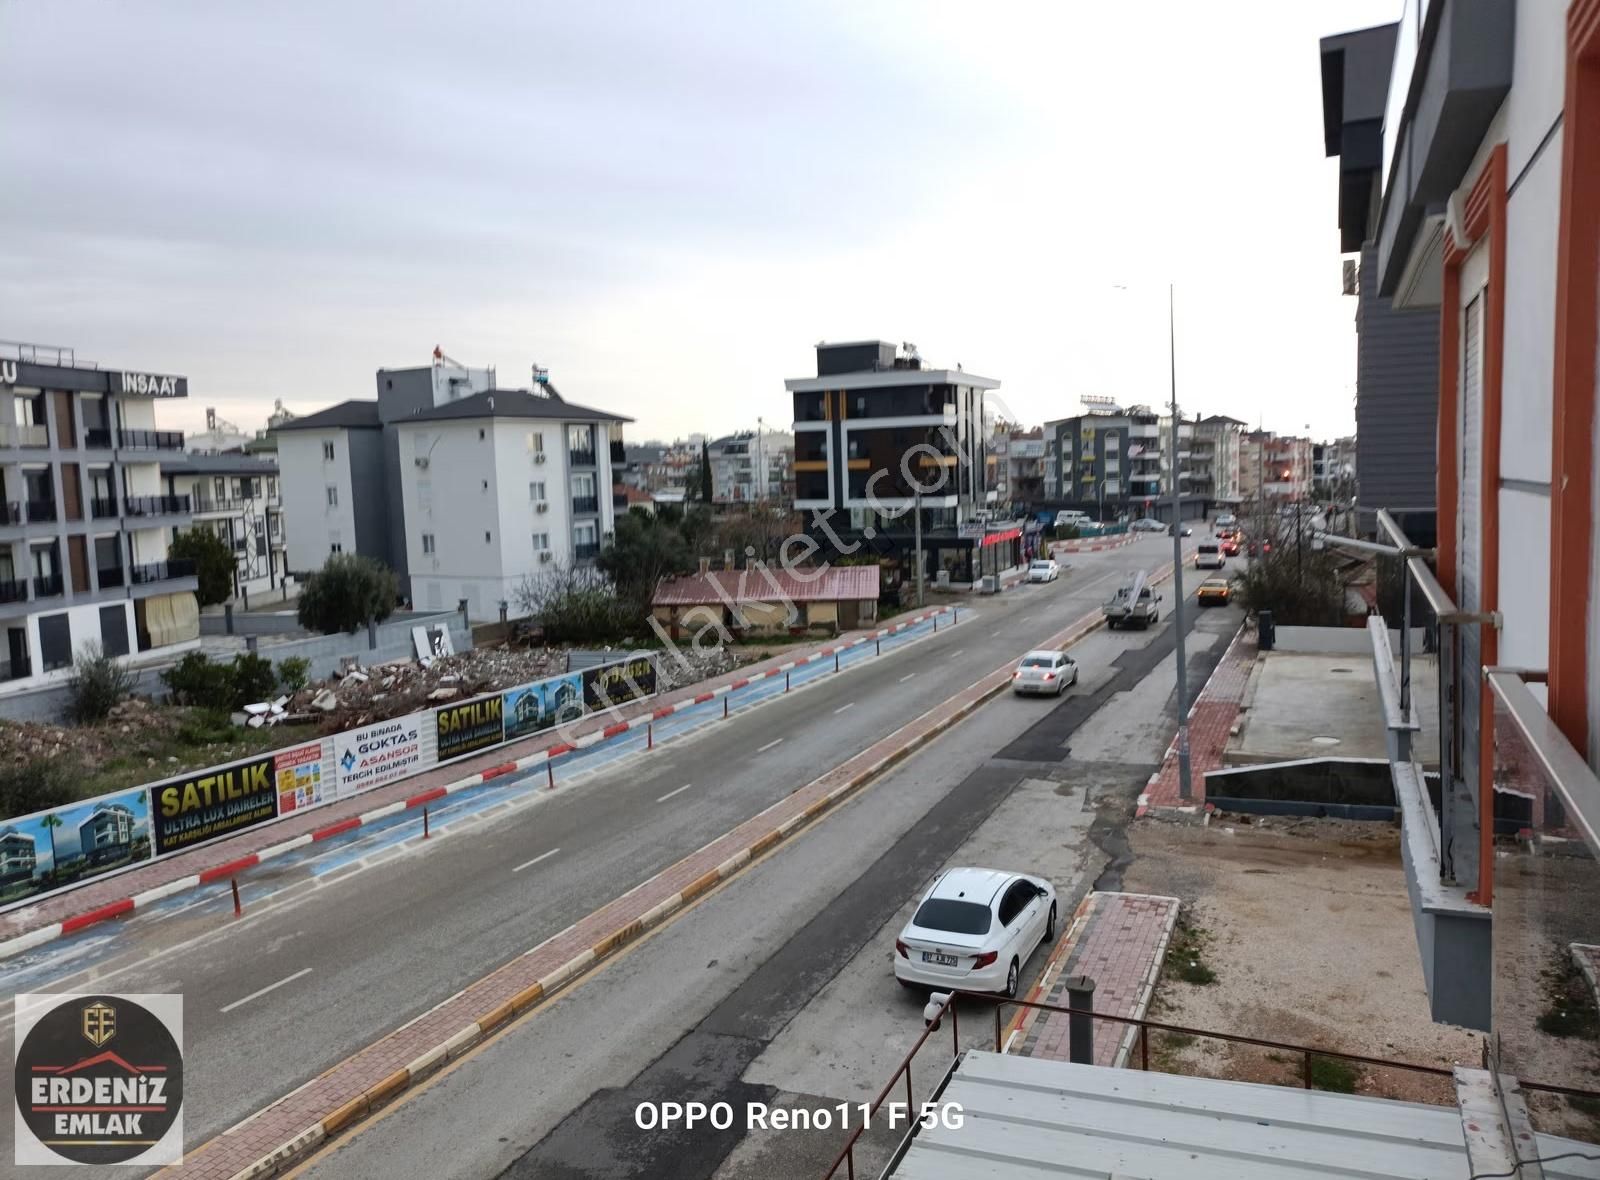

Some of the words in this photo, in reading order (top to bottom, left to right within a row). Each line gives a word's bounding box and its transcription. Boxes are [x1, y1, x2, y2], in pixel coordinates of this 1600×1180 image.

[438, 698, 502, 735] SATILIK
[356, 732, 368, 742] BU
[161, 762, 270, 817] SATILIK
[164, 814, 200, 835] ULTRA
